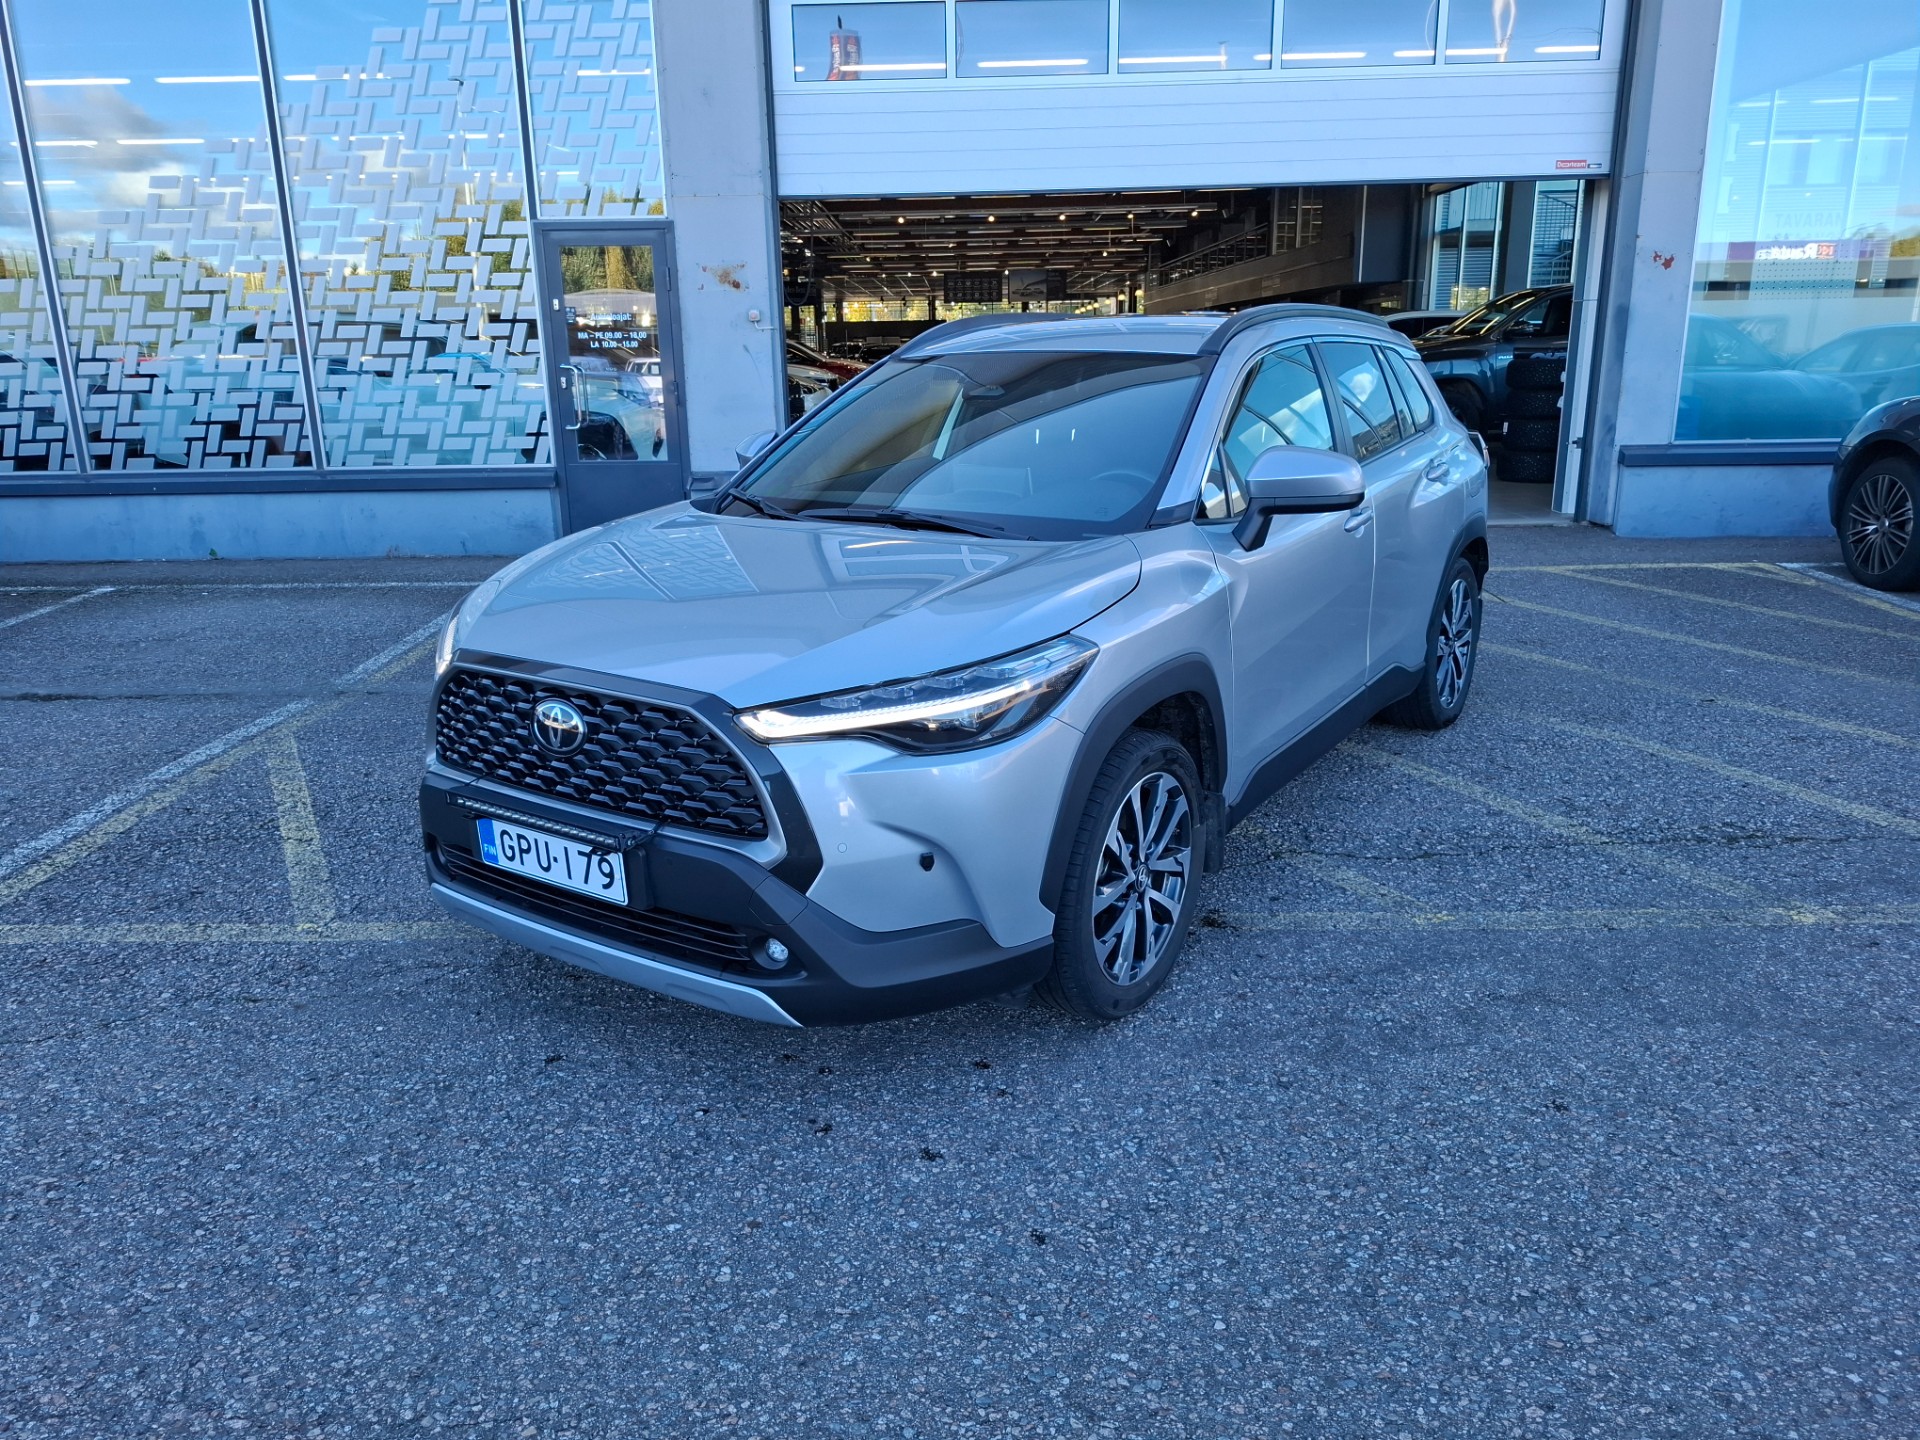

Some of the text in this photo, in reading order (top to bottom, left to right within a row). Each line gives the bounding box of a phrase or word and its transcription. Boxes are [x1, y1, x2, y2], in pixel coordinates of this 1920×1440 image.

[604, 331, 622, 339] 09.00
[484, 843, 497, 856] FIN
[499, 829, 615, 890] GPU-179
